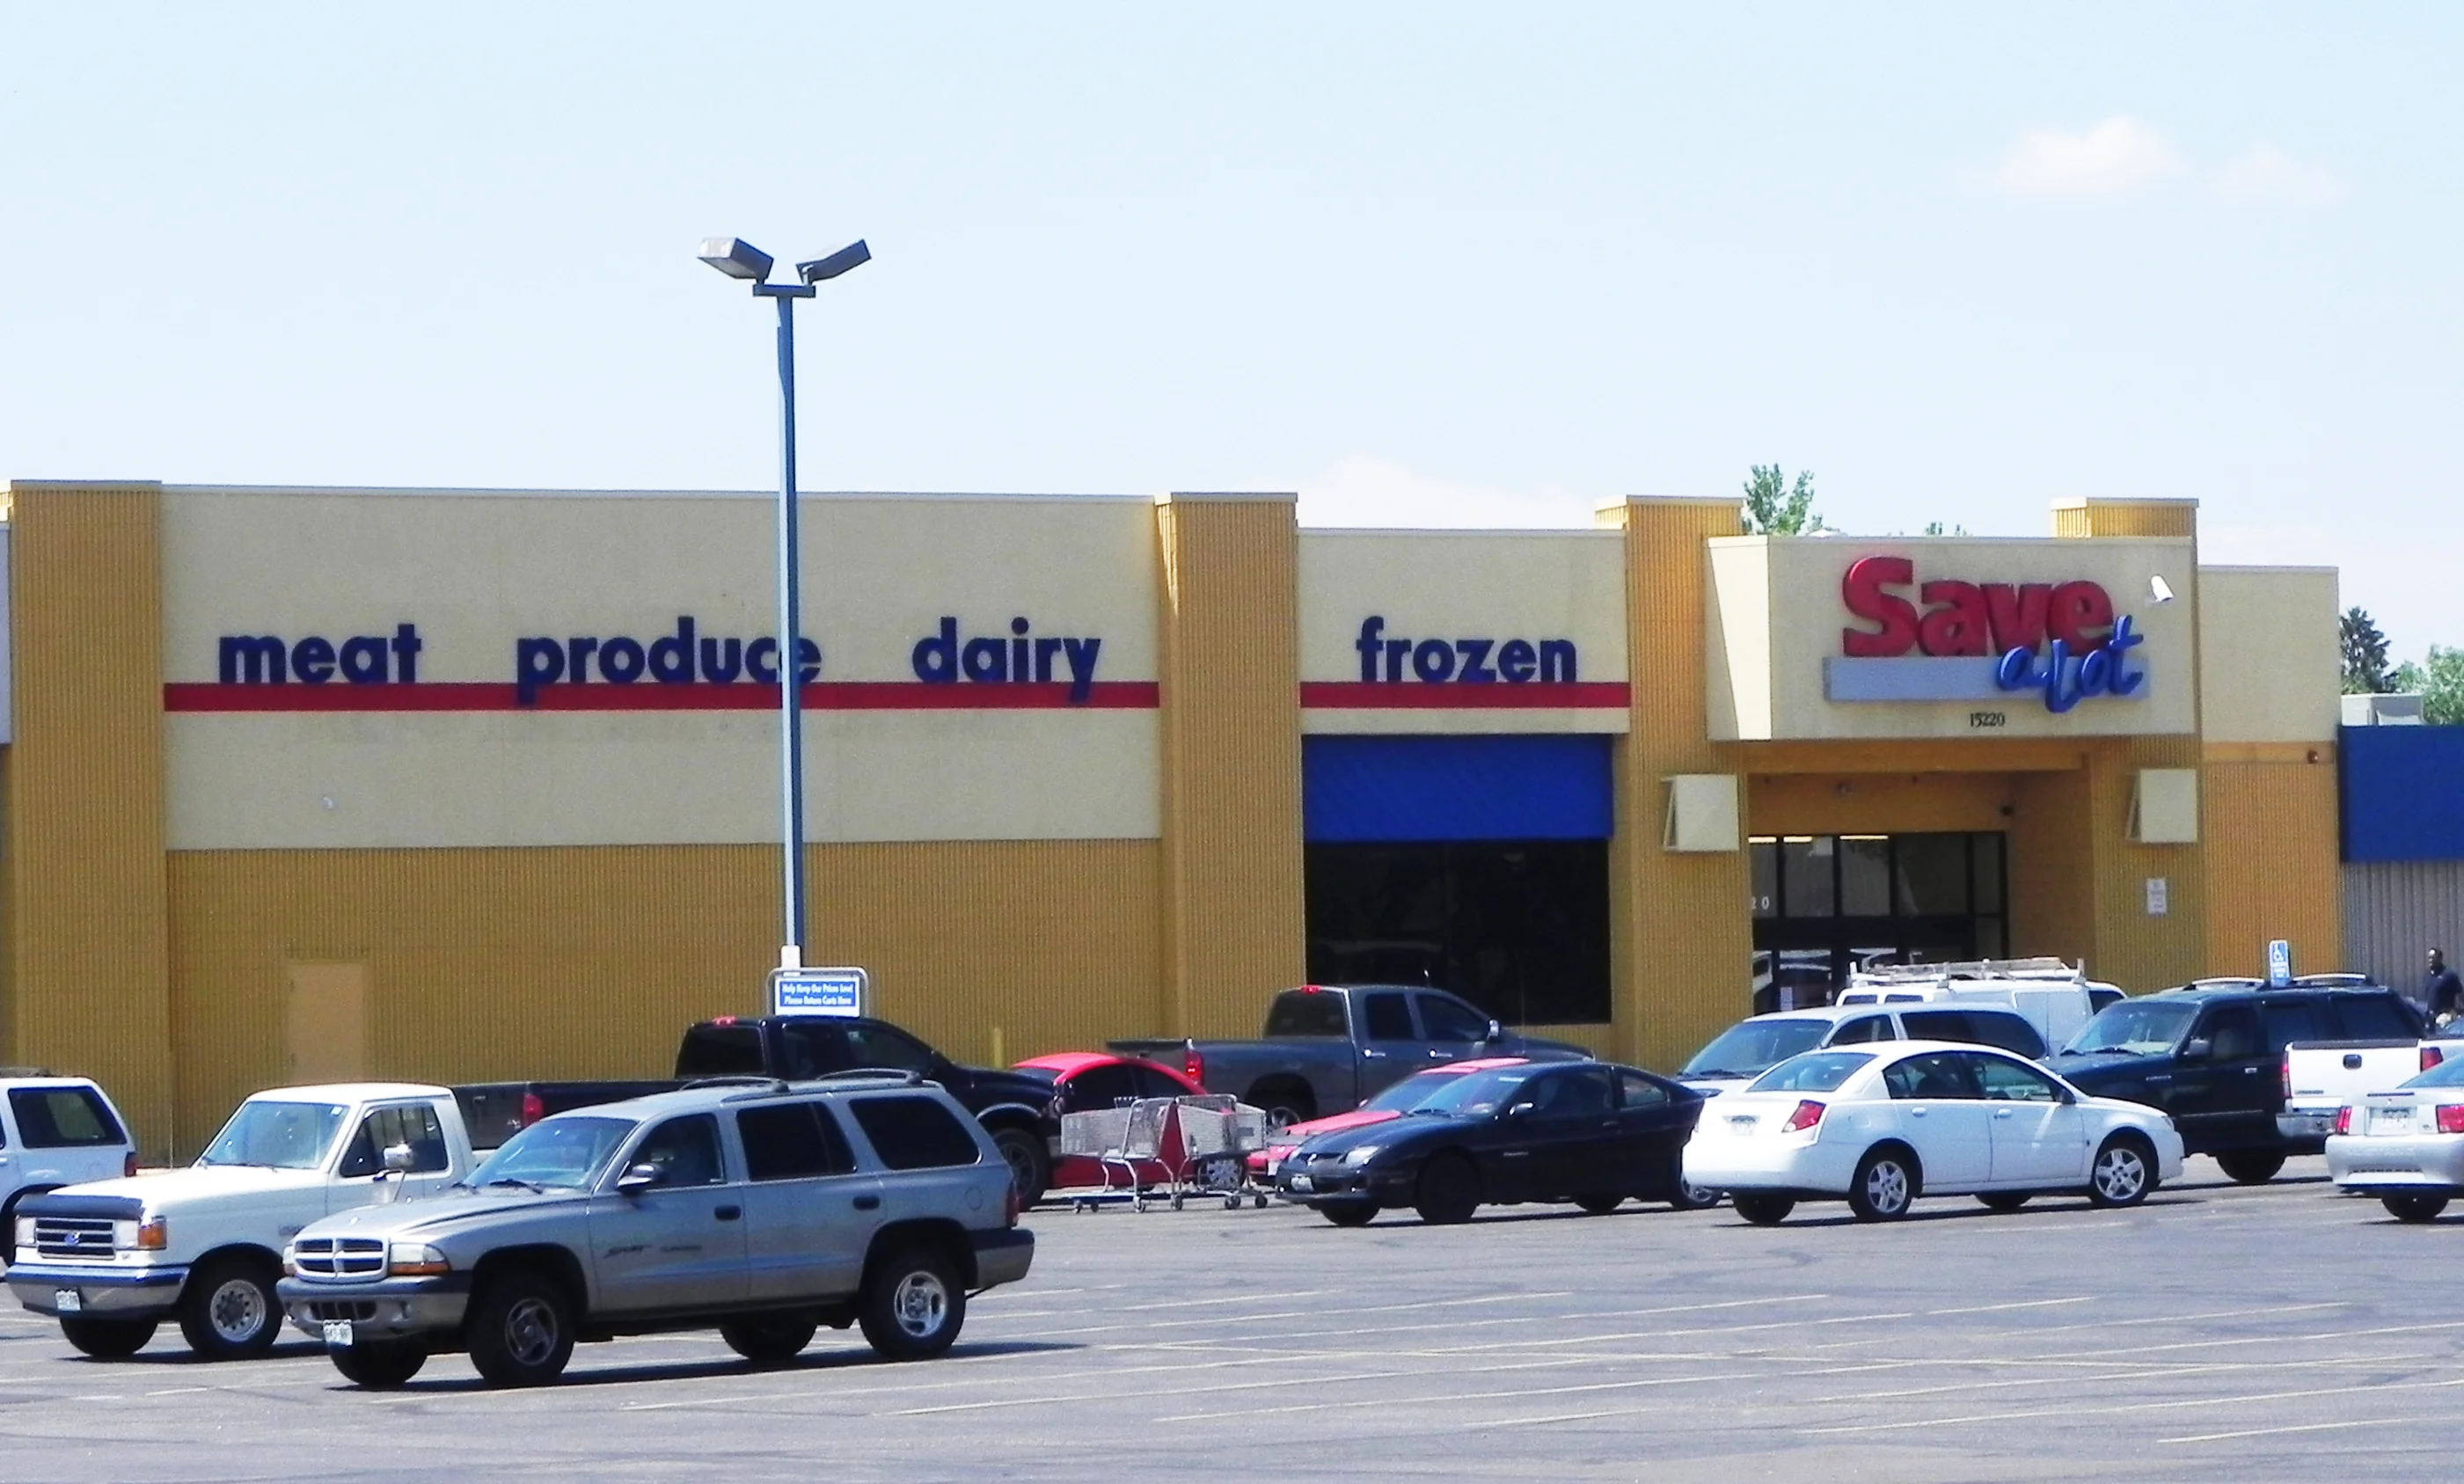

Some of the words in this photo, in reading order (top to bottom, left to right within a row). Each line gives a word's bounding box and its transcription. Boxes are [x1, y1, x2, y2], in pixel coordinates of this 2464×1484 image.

[1842, 556, 2112, 657] Save
[219, 624, 421, 686] meat
[517, 616, 822, 708] produce
[912, 617, 1101, 703] dairy
[1356, 616, 1577, 684] frozen
[1970, 712, 2006, 727] 15220
